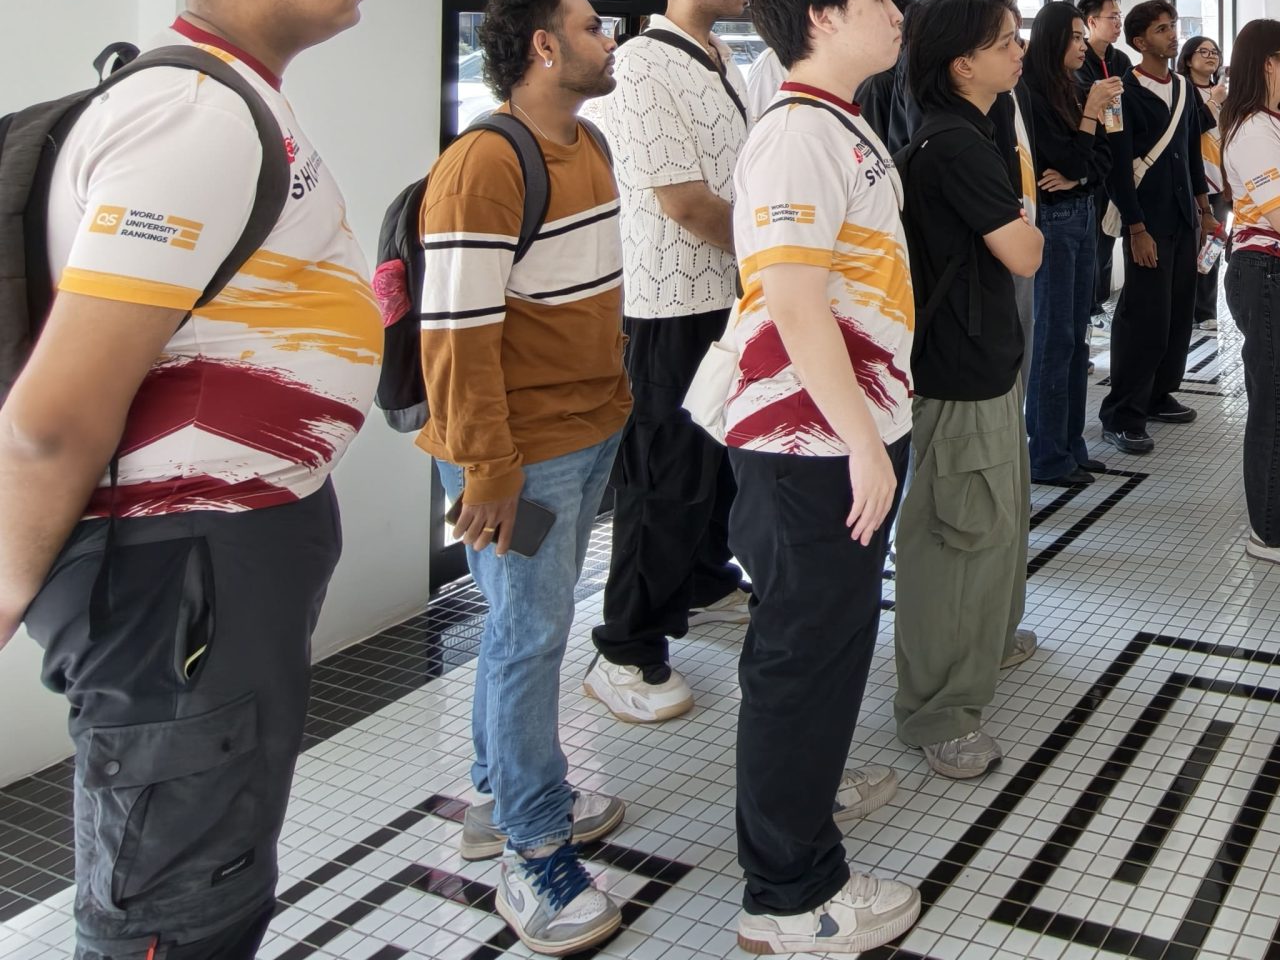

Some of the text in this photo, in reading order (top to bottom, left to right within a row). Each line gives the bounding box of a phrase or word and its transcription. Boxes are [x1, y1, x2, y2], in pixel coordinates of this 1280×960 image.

[96, 212, 119, 227] QS
[130, 209, 164, 222] WORLD
[125, 219, 178, 235] UNIVERSITY
[120, 228, 169, 244] RANKINGS
